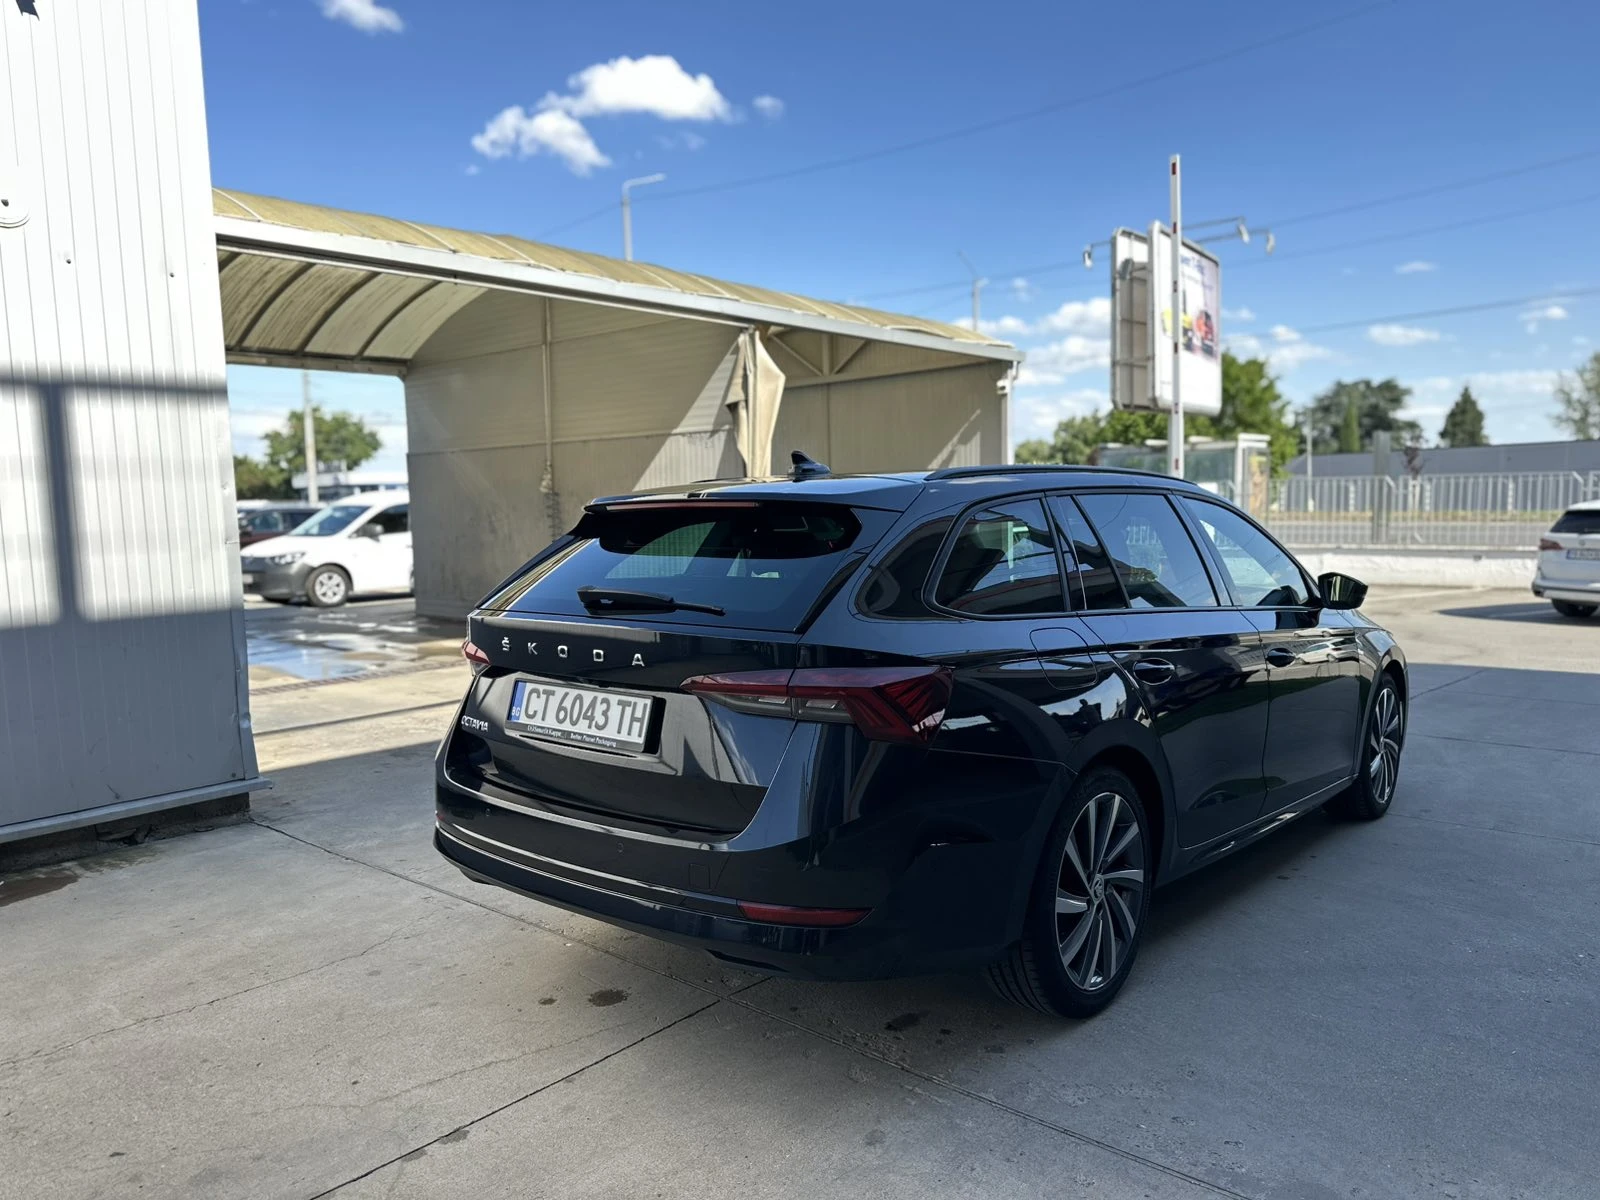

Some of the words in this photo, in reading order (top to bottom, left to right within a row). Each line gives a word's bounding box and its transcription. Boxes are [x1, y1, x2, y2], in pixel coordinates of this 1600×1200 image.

[501, 636, 645, 667] ŠKODA
[511, 706, 520, 717] BG
[524, 687, 555, 721] CT
[555, 691, 611, 731] 6043
[617, 699, 648, 738] TH
